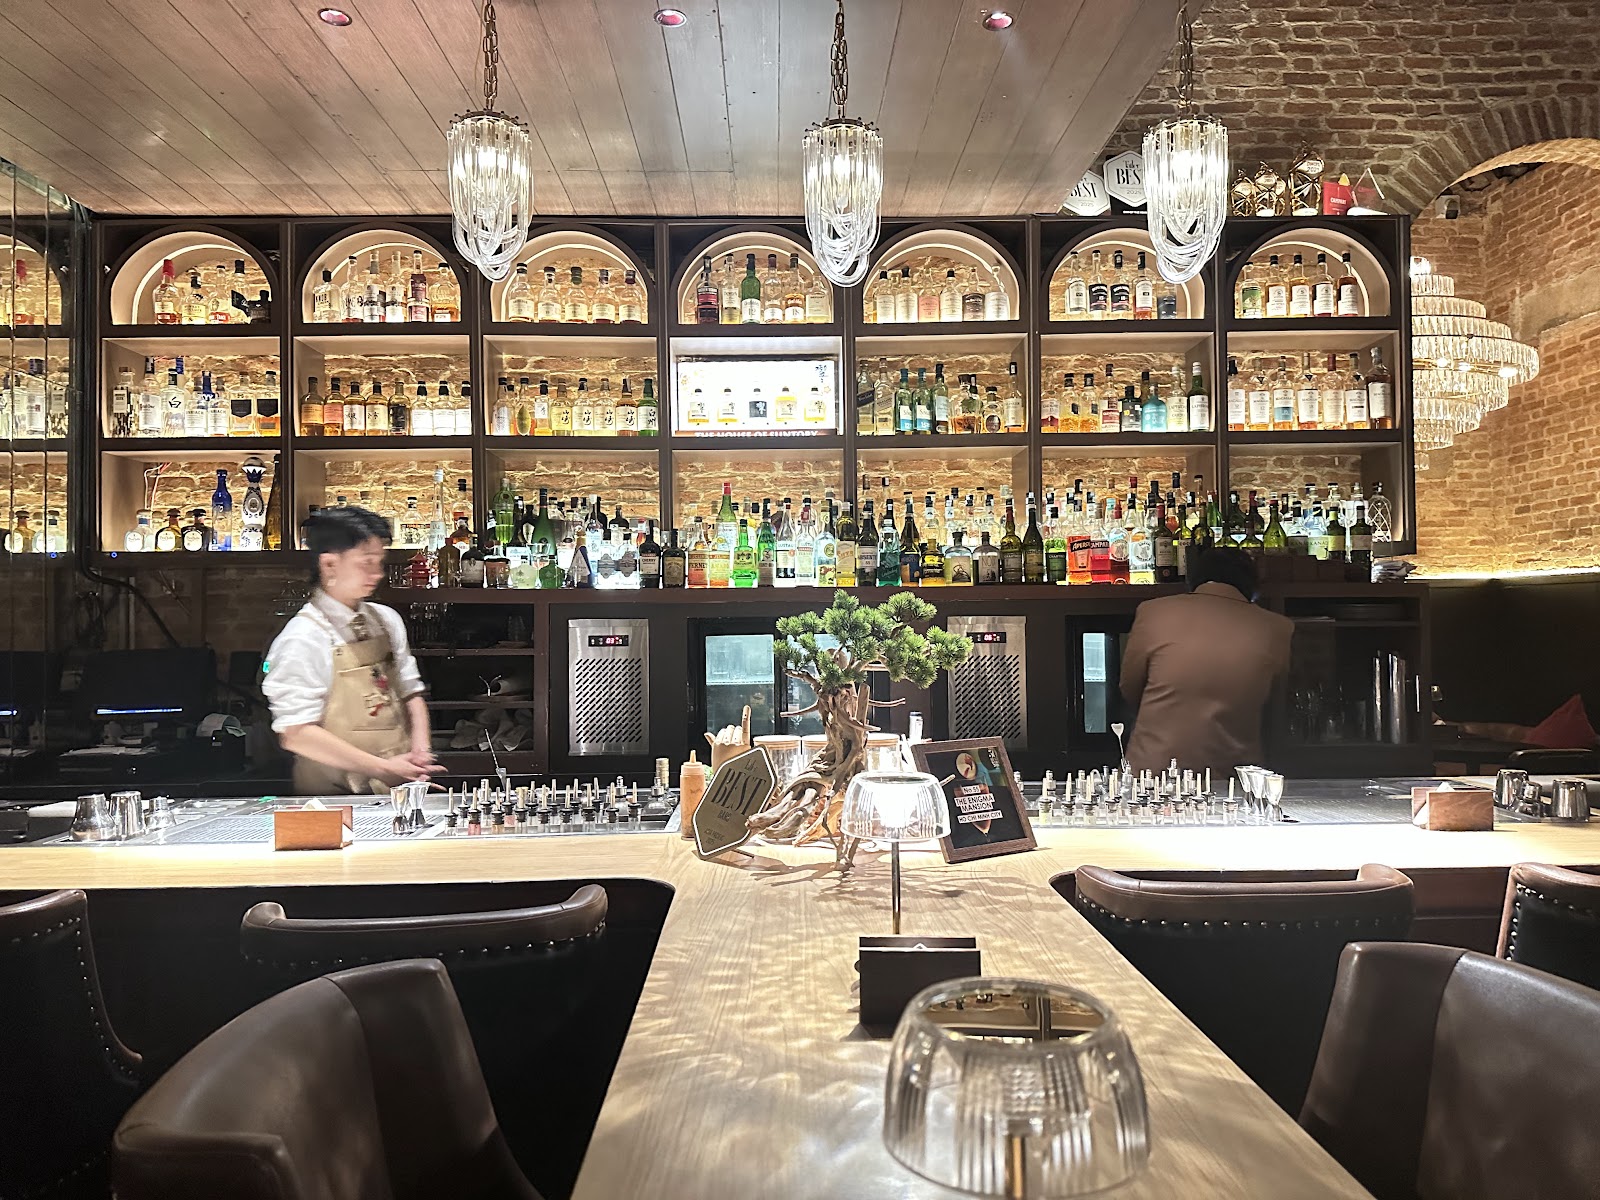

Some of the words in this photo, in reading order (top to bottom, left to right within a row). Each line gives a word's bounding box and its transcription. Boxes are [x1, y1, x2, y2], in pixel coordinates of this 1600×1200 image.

[1116, 168, 1143, 185] BES
[711, 768, 767, 815] BEST
[968, 795, 994, 804] ENIGMA
[961, 802, 992, 812] MANSION
